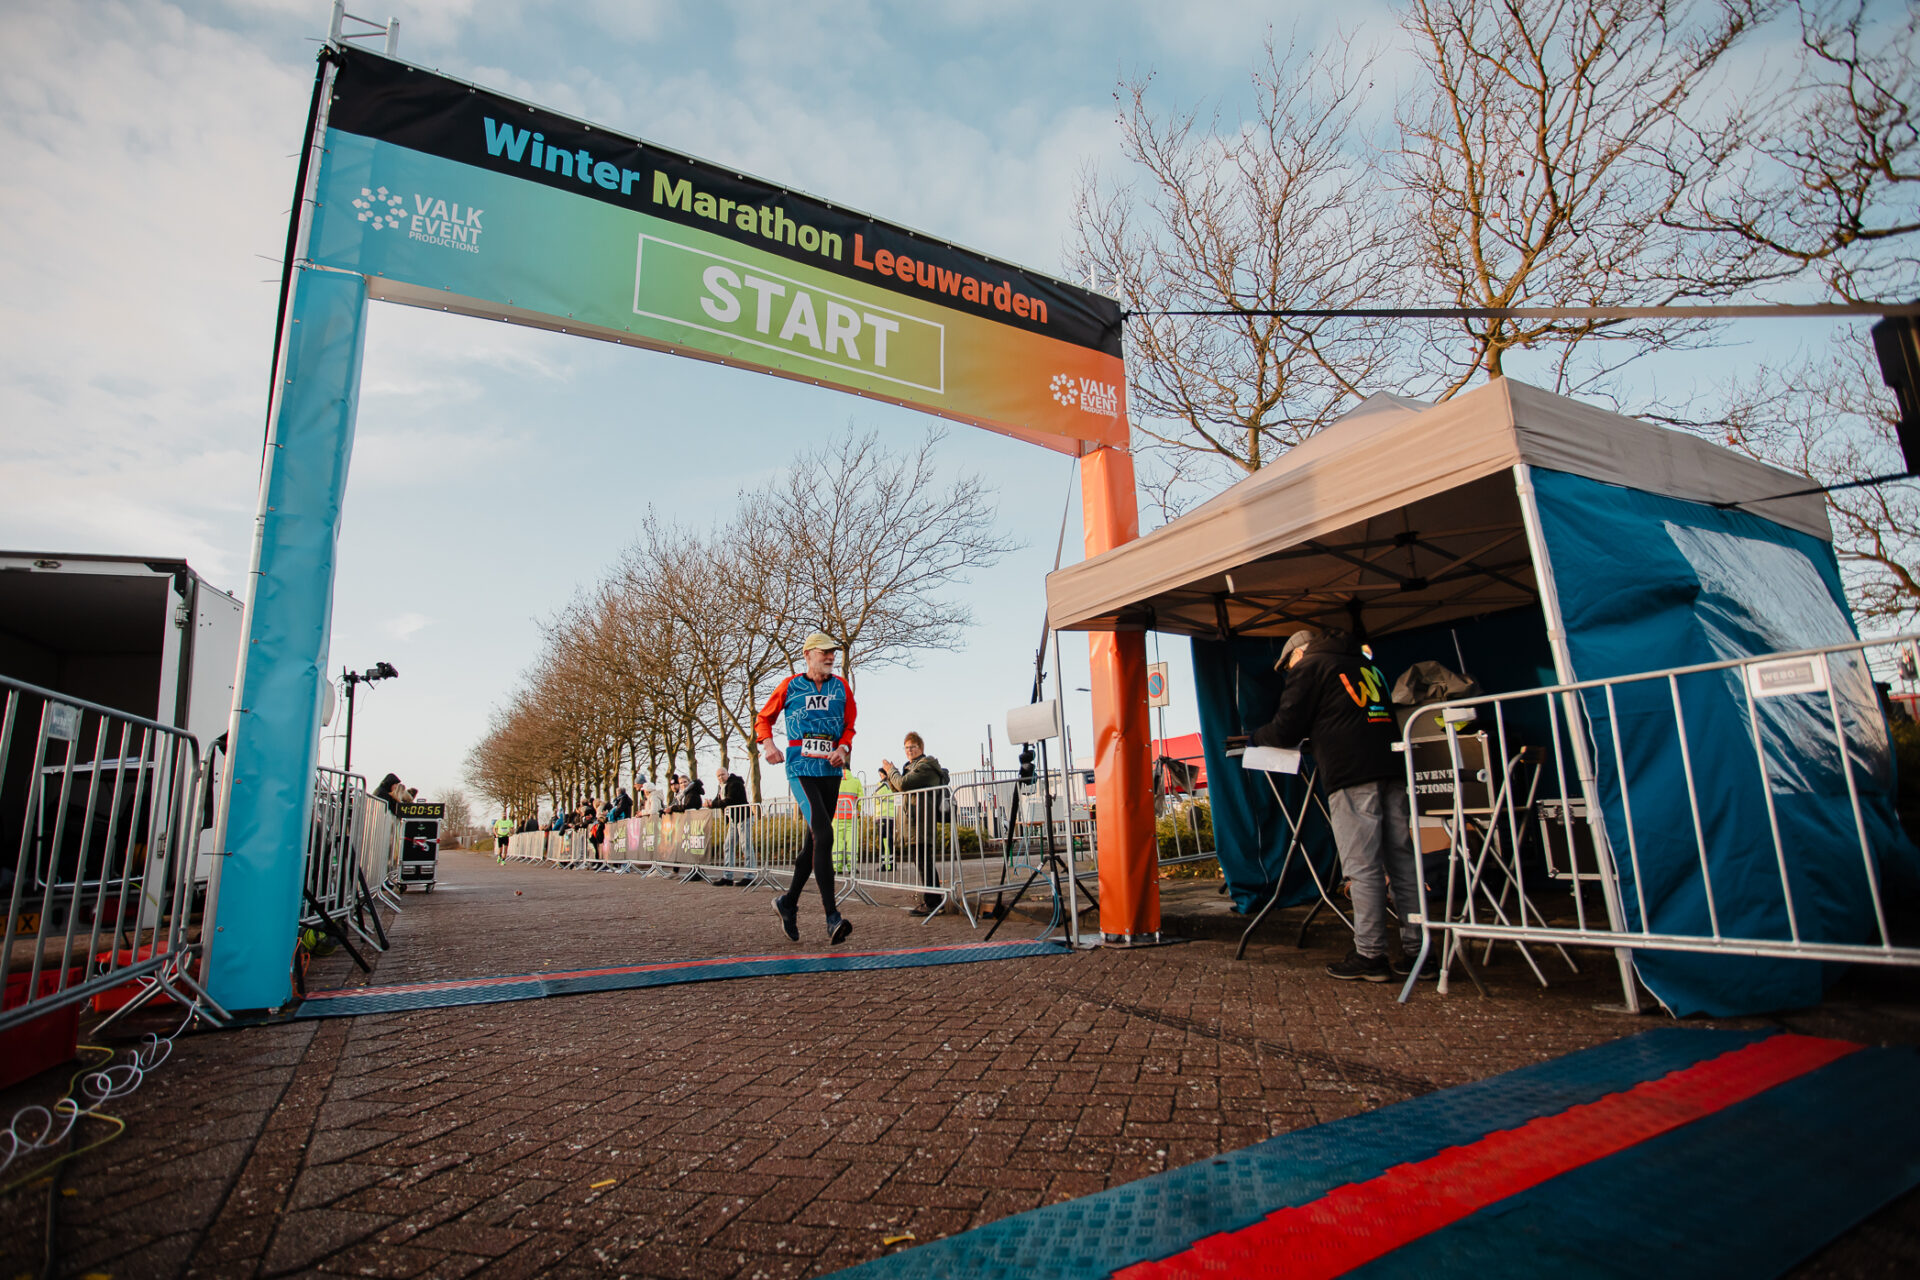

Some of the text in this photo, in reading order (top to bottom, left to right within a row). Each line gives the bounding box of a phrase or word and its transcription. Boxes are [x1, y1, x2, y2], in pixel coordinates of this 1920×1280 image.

[414, 193, 484, 229] VALK
[484, 117, 1048, 324] Winter Marathon Leeuwarden
[410, 214, 482, 245] EVENT
[408, 230, 480, 254] PRODUCTIONS
[700, 265, 899, 368] START
[1079, 377, 1118, 401] VALK
[1080, 392, 1118, 412] EVENT
[804, 740, 831, 753] 4163
[1414, 769, 1455, 781] EVENT
[1407, 783, 1455, 795] CTIONS
[401, 805, 441, 815] 4:00:56
